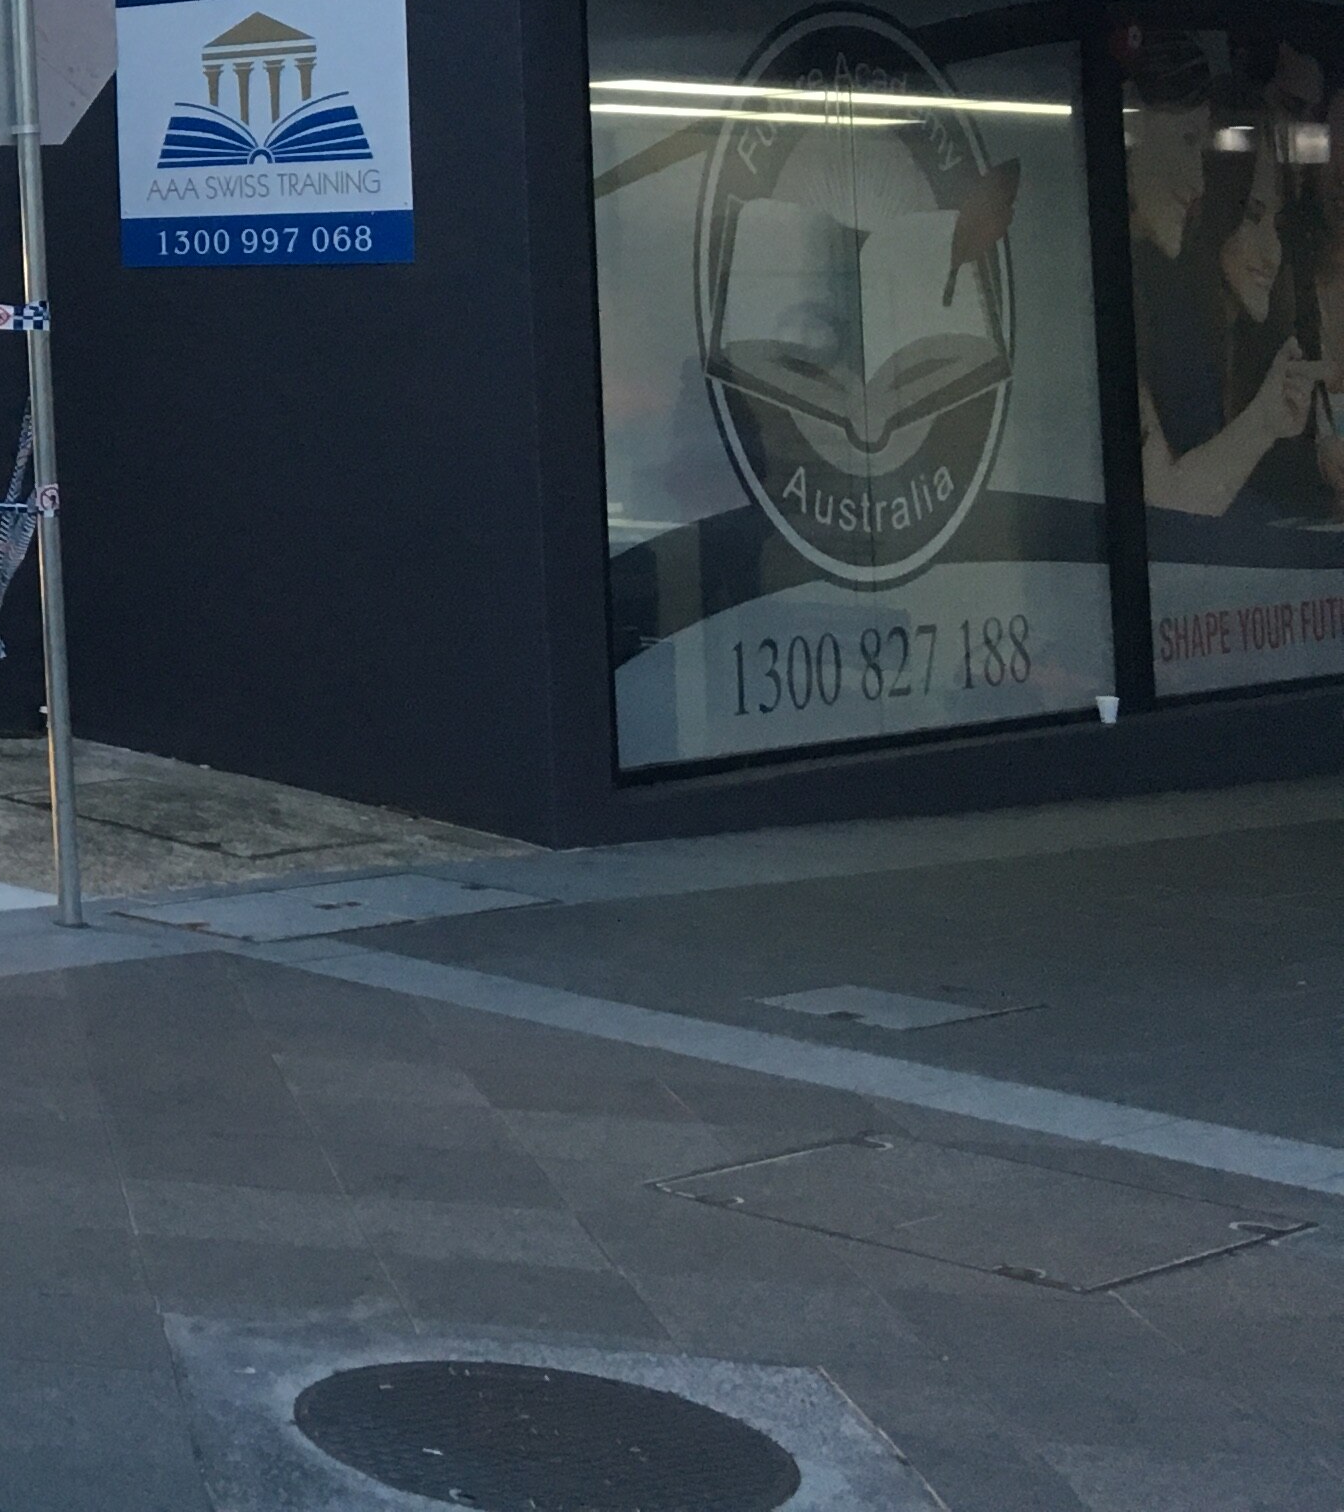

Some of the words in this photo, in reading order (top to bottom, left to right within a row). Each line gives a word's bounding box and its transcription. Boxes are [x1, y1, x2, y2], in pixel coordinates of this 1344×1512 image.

[146, 177, 201, 202] AAA
[205, 174, 270, 200] SWISS
[277, 168, 382, 196] TRAINING
[158, 228, 231, 256] 1300
[241, 227, 299, 254] 997
[312, 225, 373, 253] 068
[782, 465, 955, 533] Australia
[1159, 610, 1231, 662] SHAPE
[1238, 602, 1295, 652] YOUR
[732, 631, 842, 717] 1300
[859, 624, 938, 701] 827
[959, 614, 1032, 690] 188
